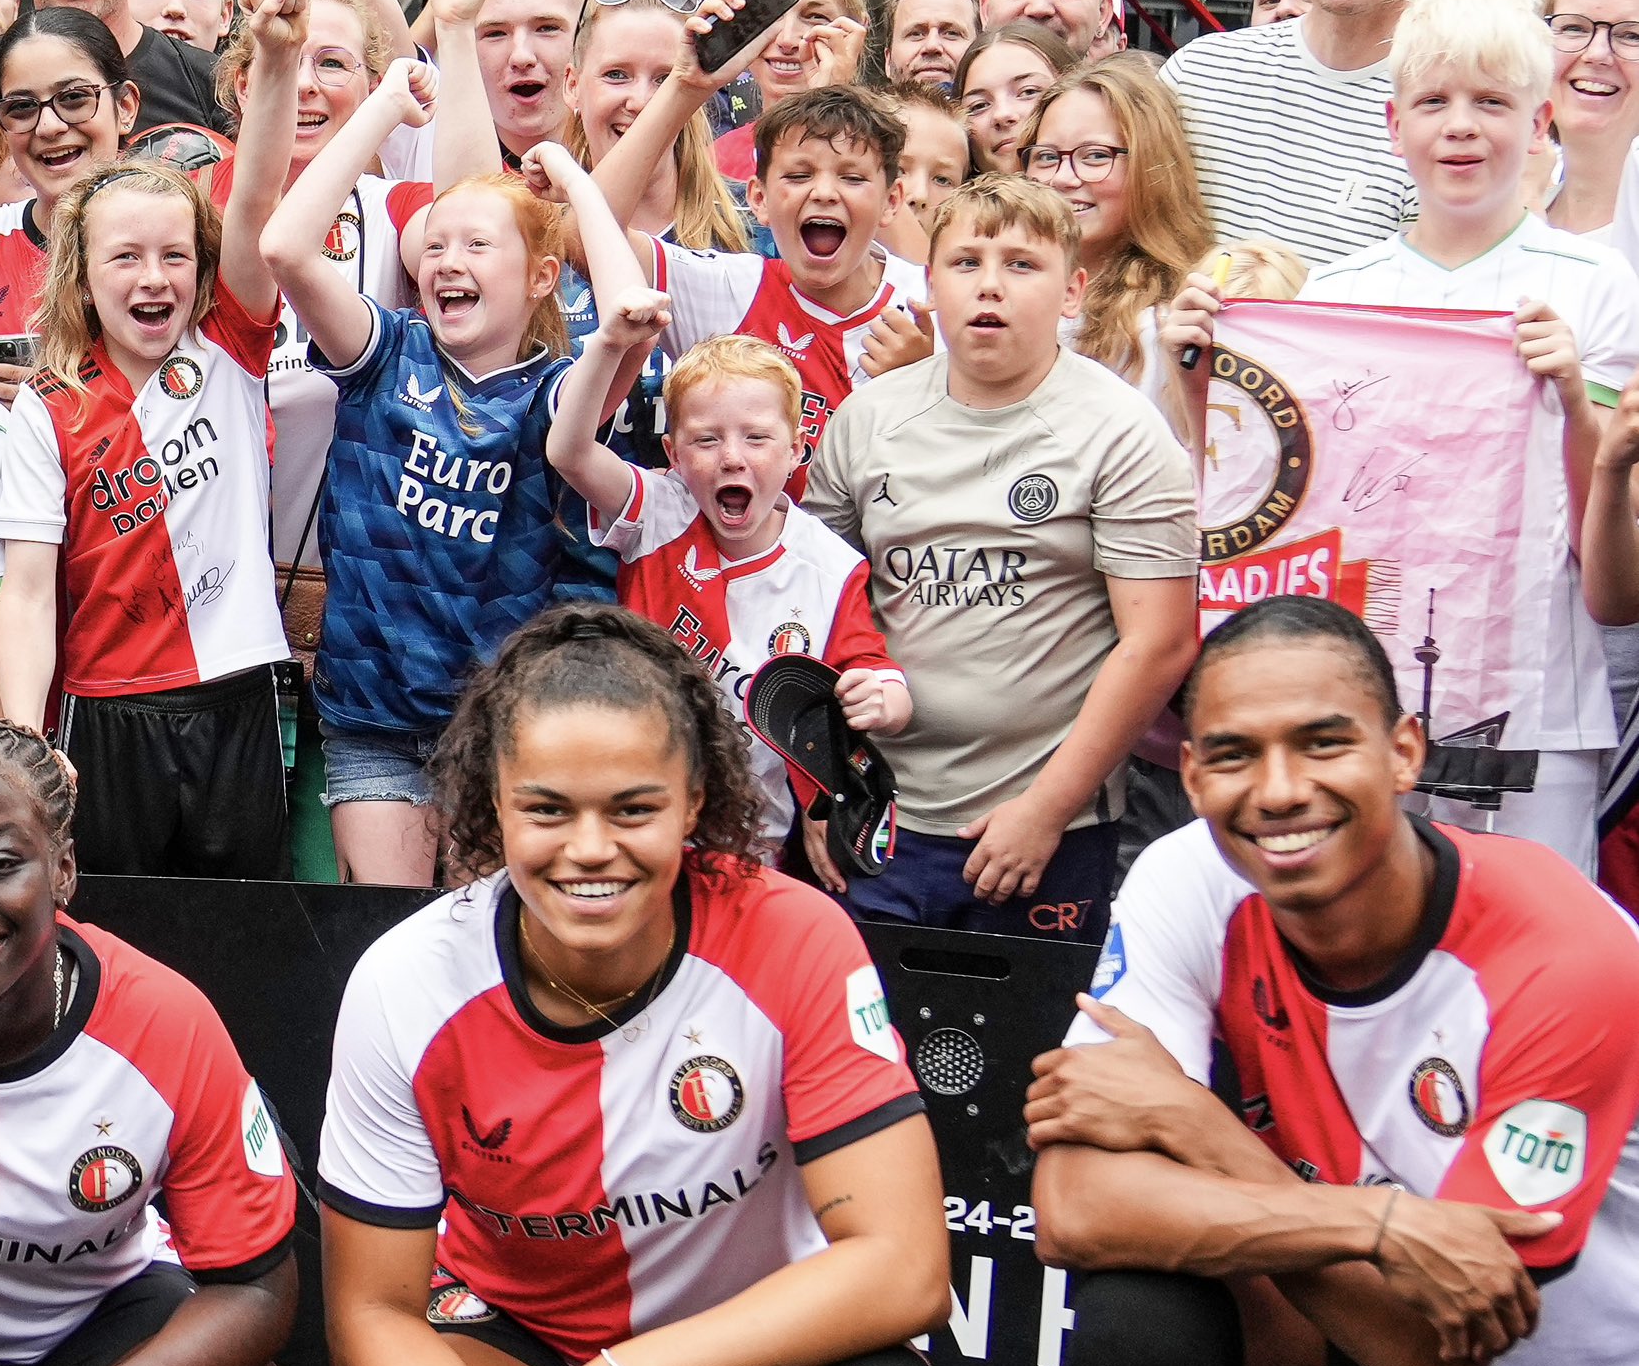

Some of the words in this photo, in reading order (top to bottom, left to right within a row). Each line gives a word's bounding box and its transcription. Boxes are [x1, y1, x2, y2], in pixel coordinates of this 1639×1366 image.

[564, 313, 594, 322] STORE
[397, 392, 434, 414] CASTORE
[90, 417, 219, 510] droom
[404, 428, 513, 497] Euro
[1018, 477, 1049, 490] PARIS
[885, 545, 1029, 591] QATAR
[909, 582, 1026, 608] AIRWAYS
[1028, 899, 1093, 931] CR7
[72, 1146, 139, 1177] FEYENOORD
[1502, 1123, 1578, 1174] TOTO
